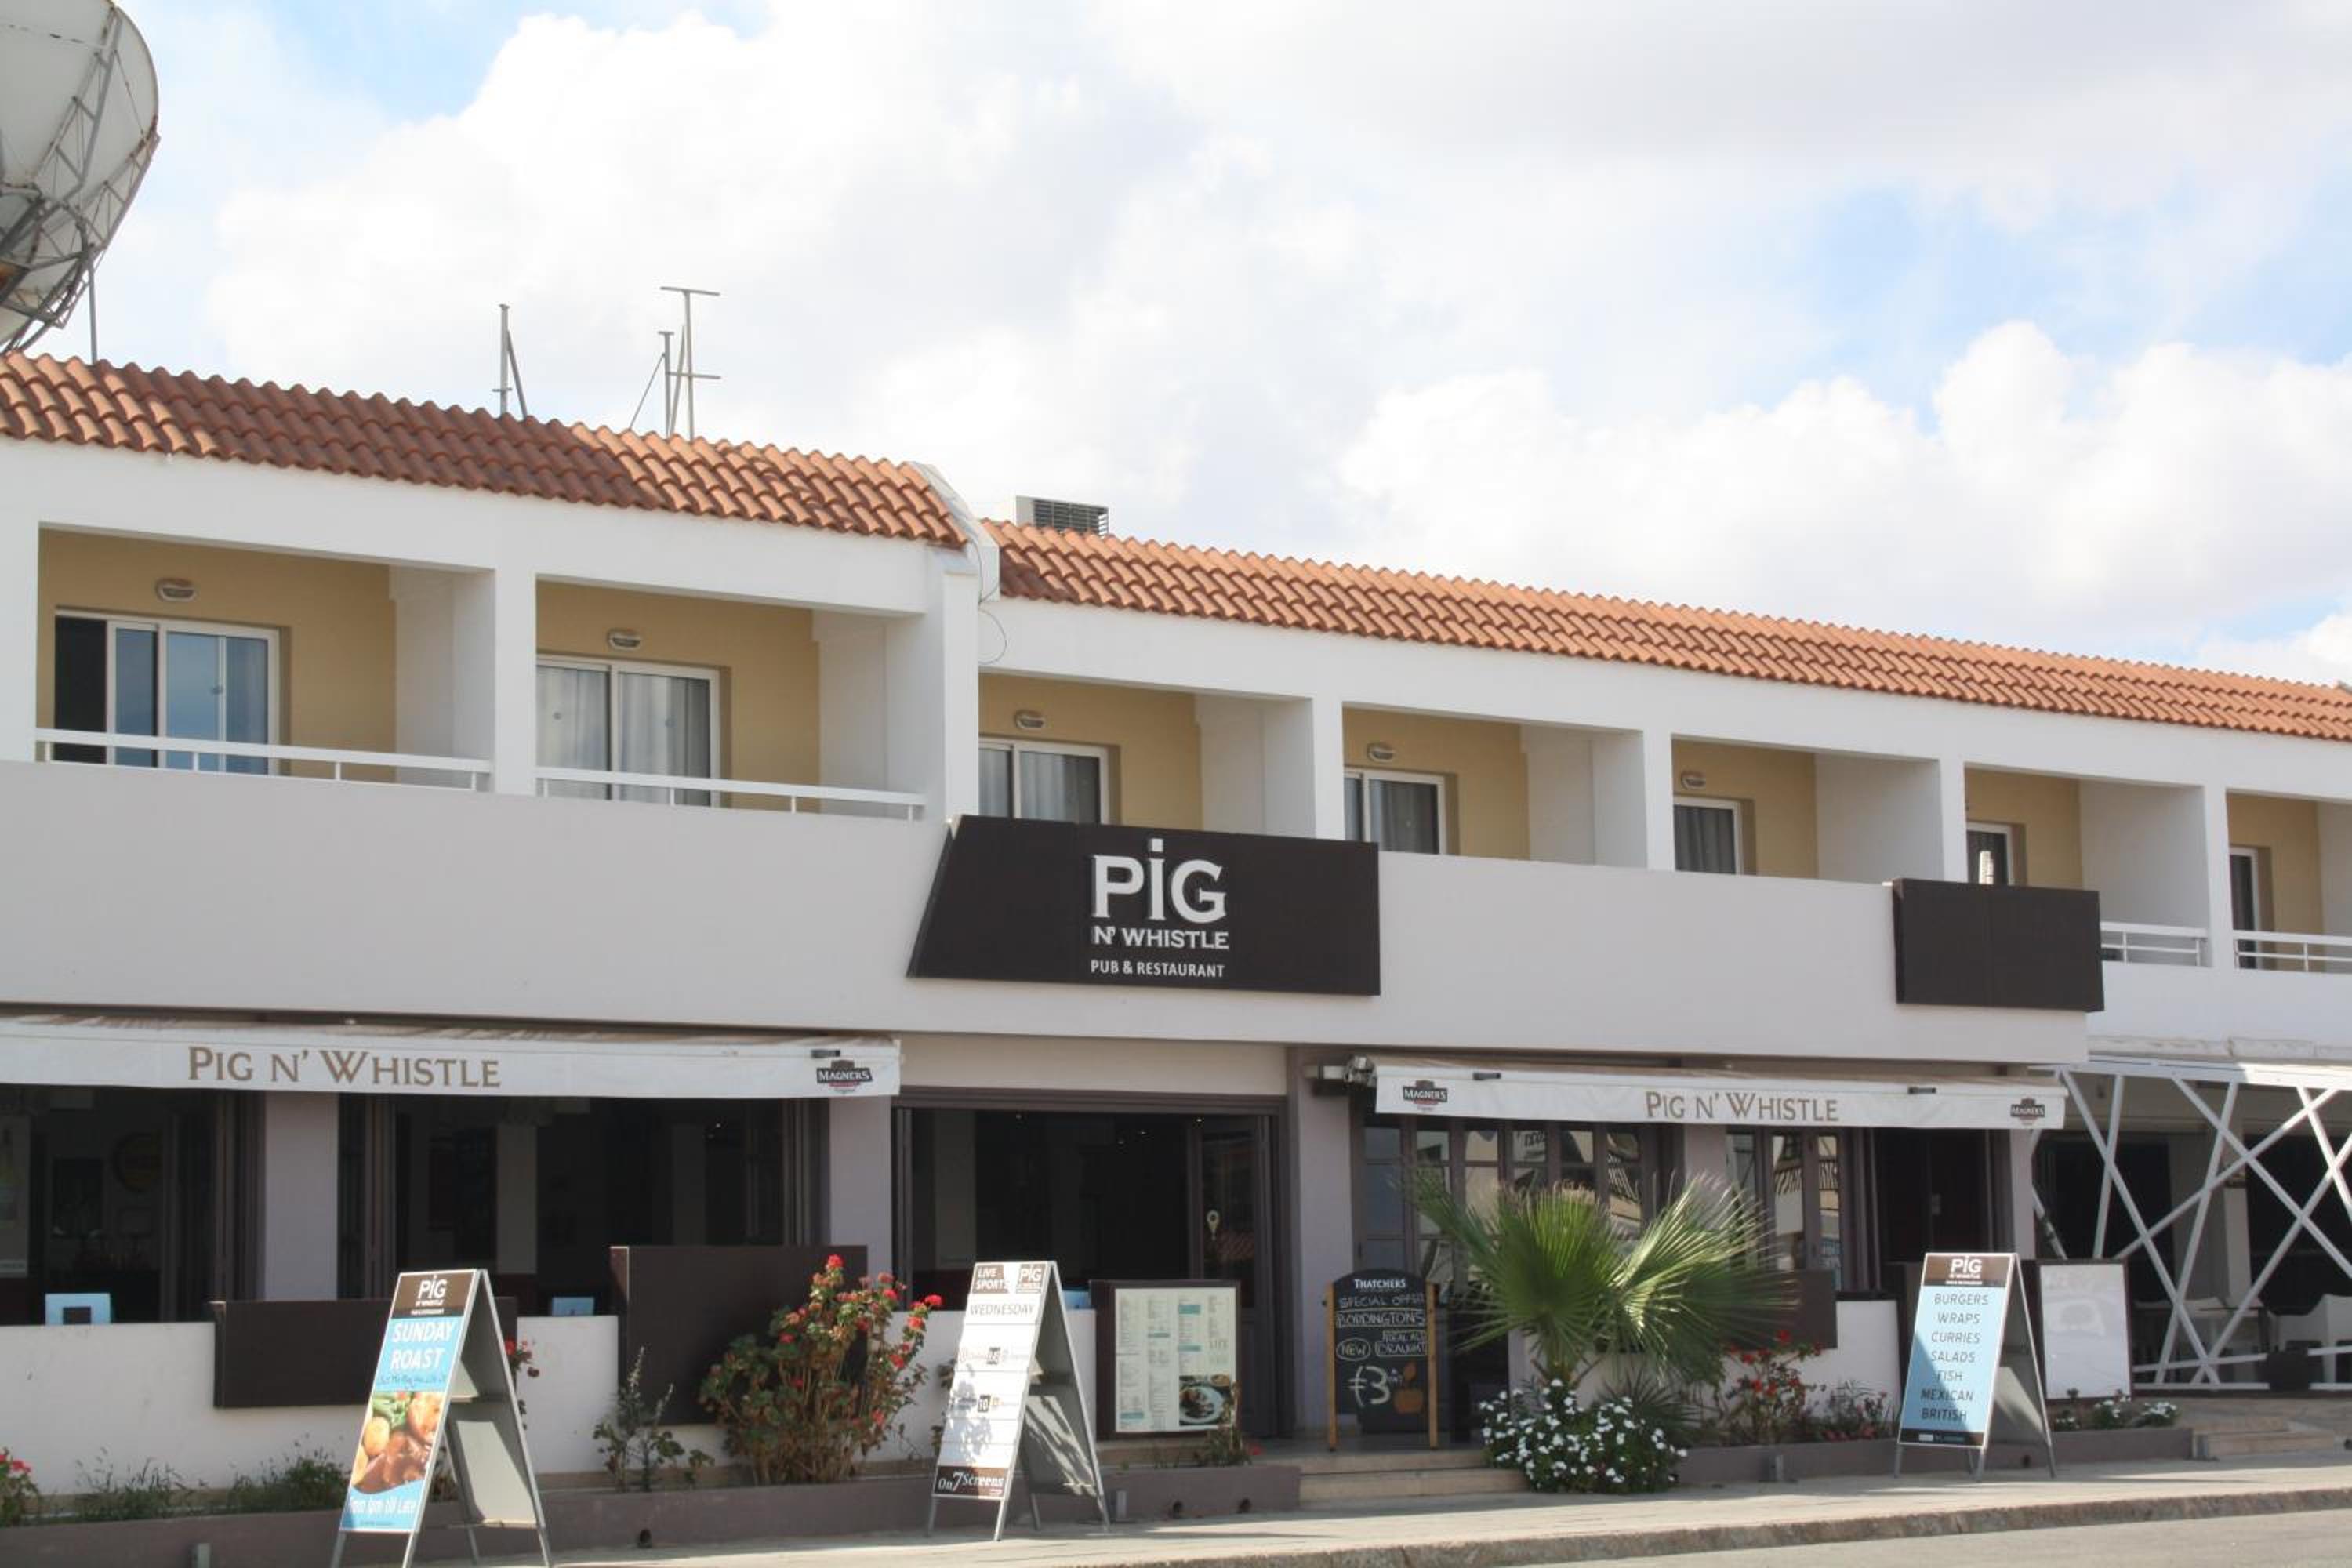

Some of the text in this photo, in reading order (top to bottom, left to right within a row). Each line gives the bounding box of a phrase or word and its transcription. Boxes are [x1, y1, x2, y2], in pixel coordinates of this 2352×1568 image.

[1122, 927, 1229, 949] WHISTLE
[1091, 960, 1225, 978] PUB & RESTAURANT
[978, 1268, 997, 1279] LIVE
[1355, 1279, 1406, 1288] THATCHERS
[1934, 1294, 1989, 1305] BURGERS
[970, 1304, 1035, 1316] WEDNESDAY
[1938, 1312, 1980, 1323] WRAPS
[392, 1322, 454, 1343] SUNDAY
[1931, 1332, 1981, 1343] CURRIES
[1342, 1345, 1366, 1356] NEW
[390, 1348, 445, 1370] ROAST
[1931, 1351, 1976, 1363] SALADS
[1937, 1370, 1962, 1381] FISH
[1920, 1388, 1973, 1401] MEXICAN
[1922, 1408, 1967, 1421] BRITISH
